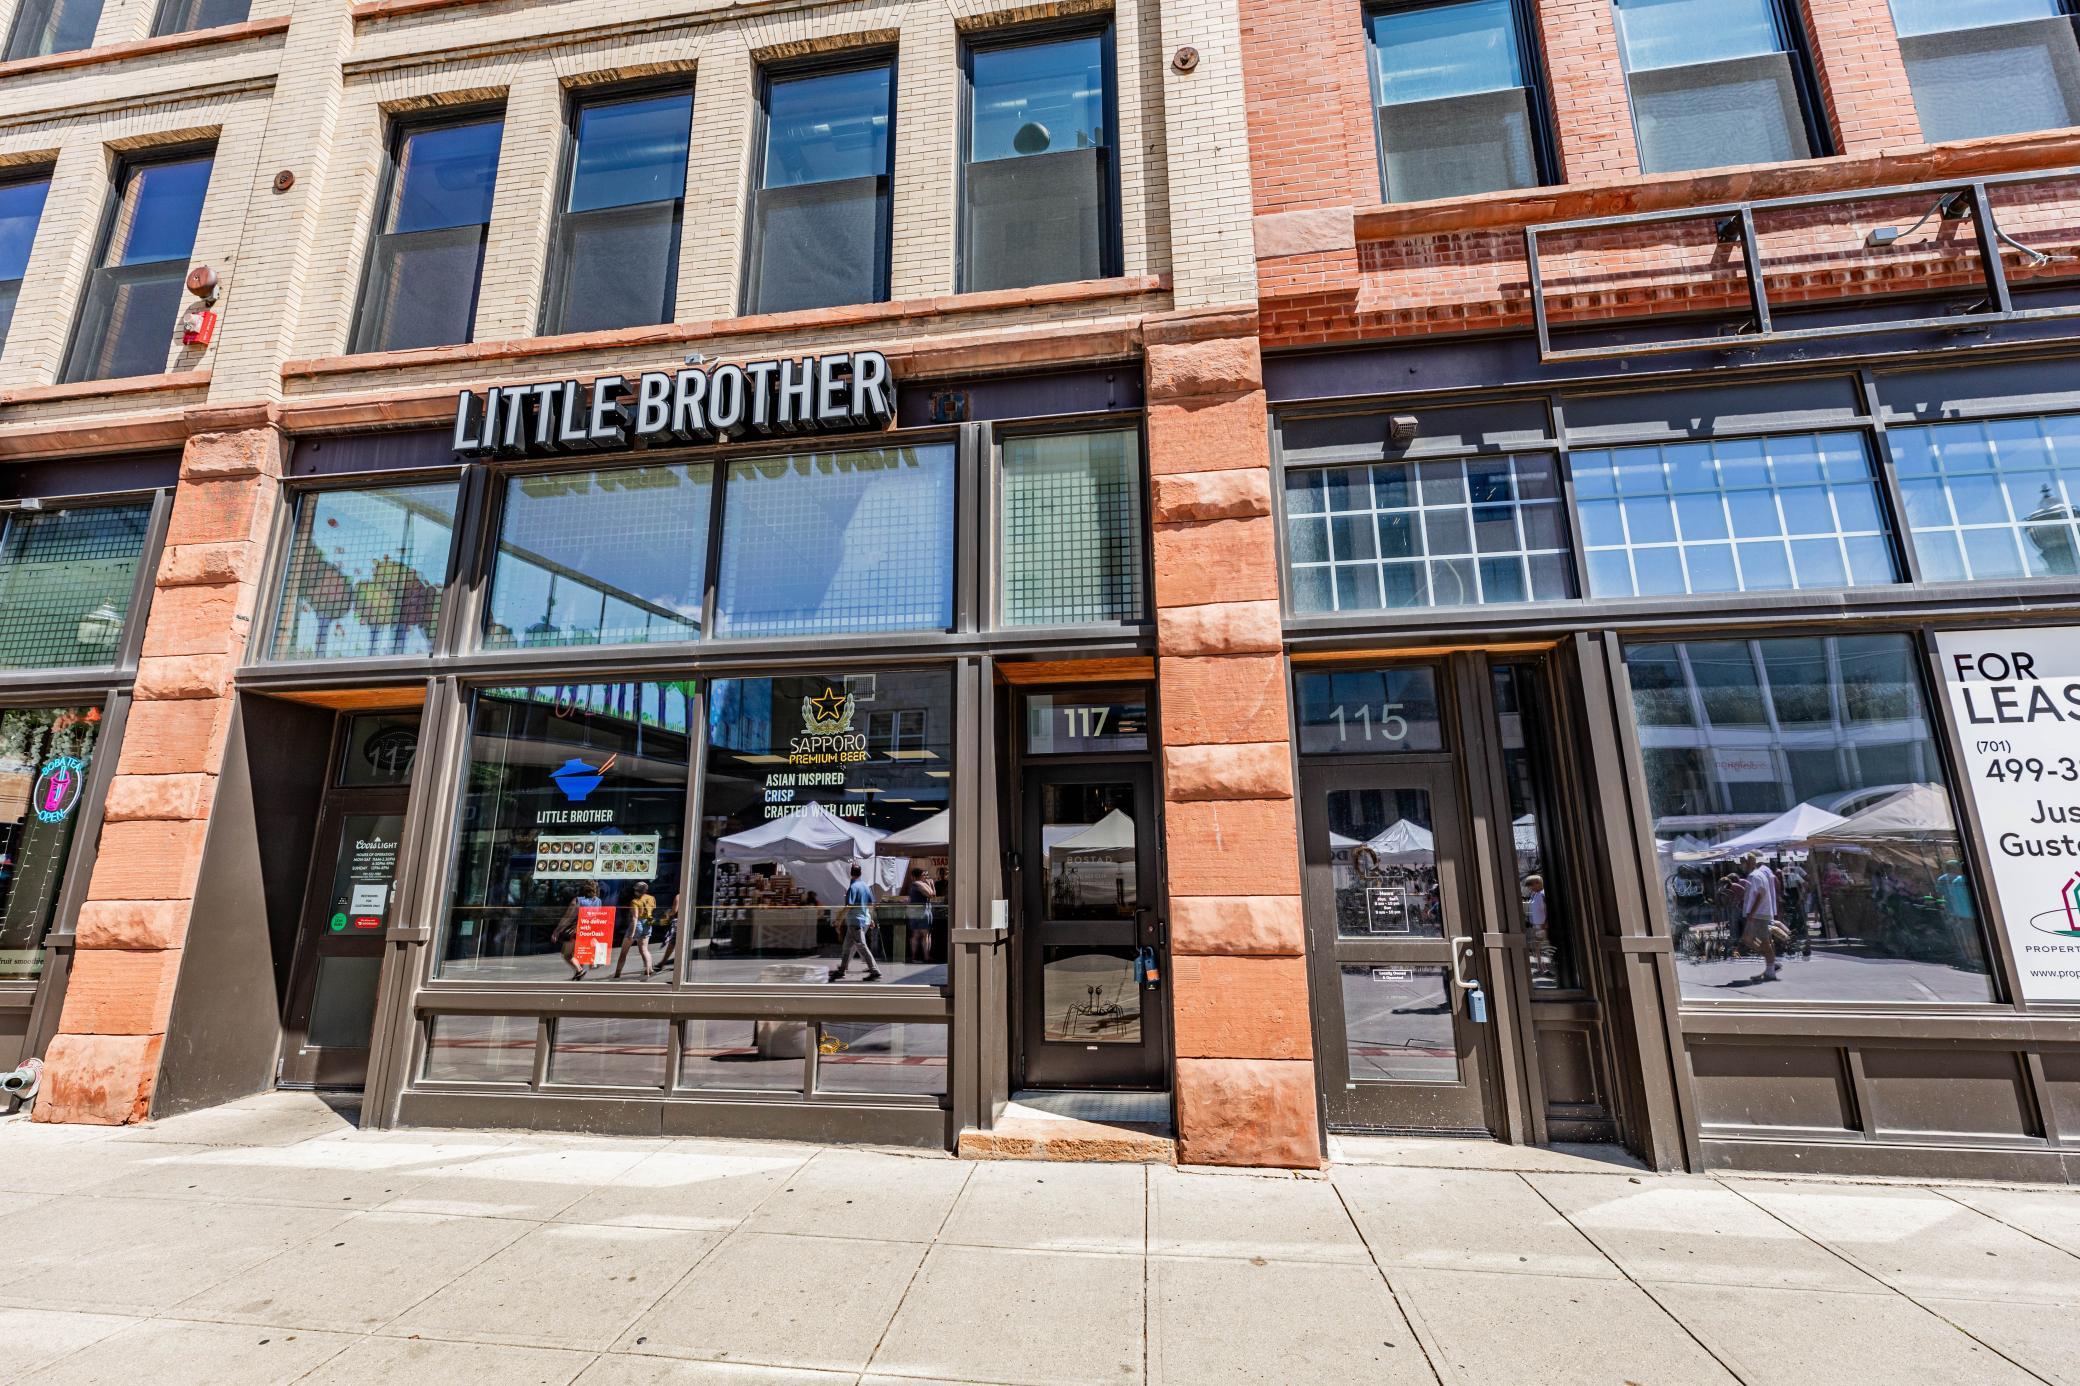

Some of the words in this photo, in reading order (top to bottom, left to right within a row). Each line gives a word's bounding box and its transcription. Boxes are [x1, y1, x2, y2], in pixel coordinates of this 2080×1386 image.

[453, 375, 628, 451] LITTLE
[635, 350, 890, 438] BROTHER
[1953, 652, 2039, 682] FOR
[1064, 707, 1110, 738] 117
[1329, 704, 1408, 741] 115
[790, 733, 866, 754] SAPPORO
[1976, 740, 2011, 754] (701)
[42, 757, 66, 775] BOBA
[67, 757, 82, 771] TEA
[789, 754, 838, 765] PREMIUM
[840, 751, 867, 762] BEER
[766, 773, 796, 787] ASIAN
[798, 772, 845, 785] INSPIRED
[764, 789, 795, 803] CRISP
[39, 808, 65, 821] OPEN
[536, 810, 569, 824] LITTLE
[570, 809, 614, 822] BROTHER
[764, 805, 808, 819] CRAFTED
[811, 803, 838, 818] WITH
[840, 803, 866, 817] LOVE
[2030, 799, 2080, 824] Jus
[355, 839, 377, 850] Coors
[1999, 832, 2080, 857] Gust
[1066, 855, 1113, 864] BOSTAD
